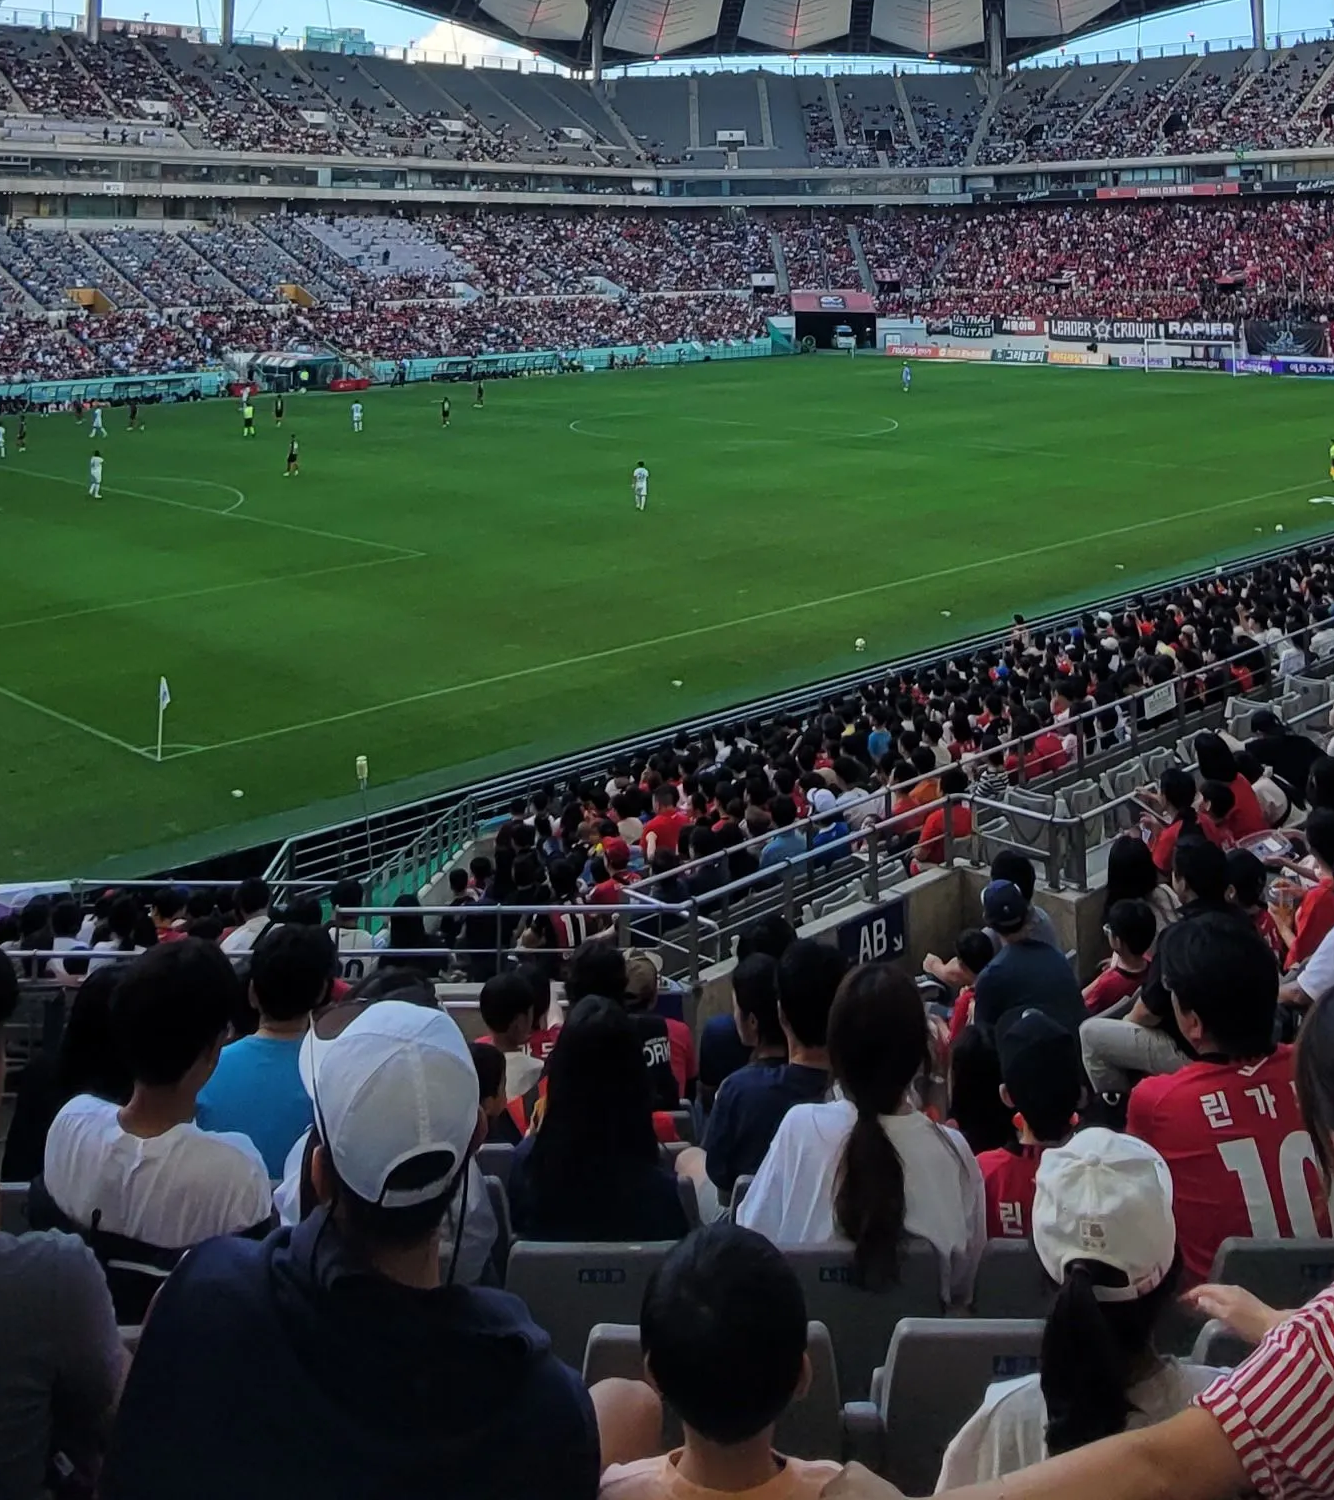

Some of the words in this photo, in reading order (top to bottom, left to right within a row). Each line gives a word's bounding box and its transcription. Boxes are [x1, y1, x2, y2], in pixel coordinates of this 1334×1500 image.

[952, 313, 991, 325] ULTRAS
[1051, 320, 1092, 337] LEADER
[1113, 322, 1156, 338] CROWN
[1168, 321, 1234, 336] RAPIER
[562, 913, 587, 949] 11
[859, 918, 887, 965] AB
[1199, 1080, 1299, 1129] 린가
